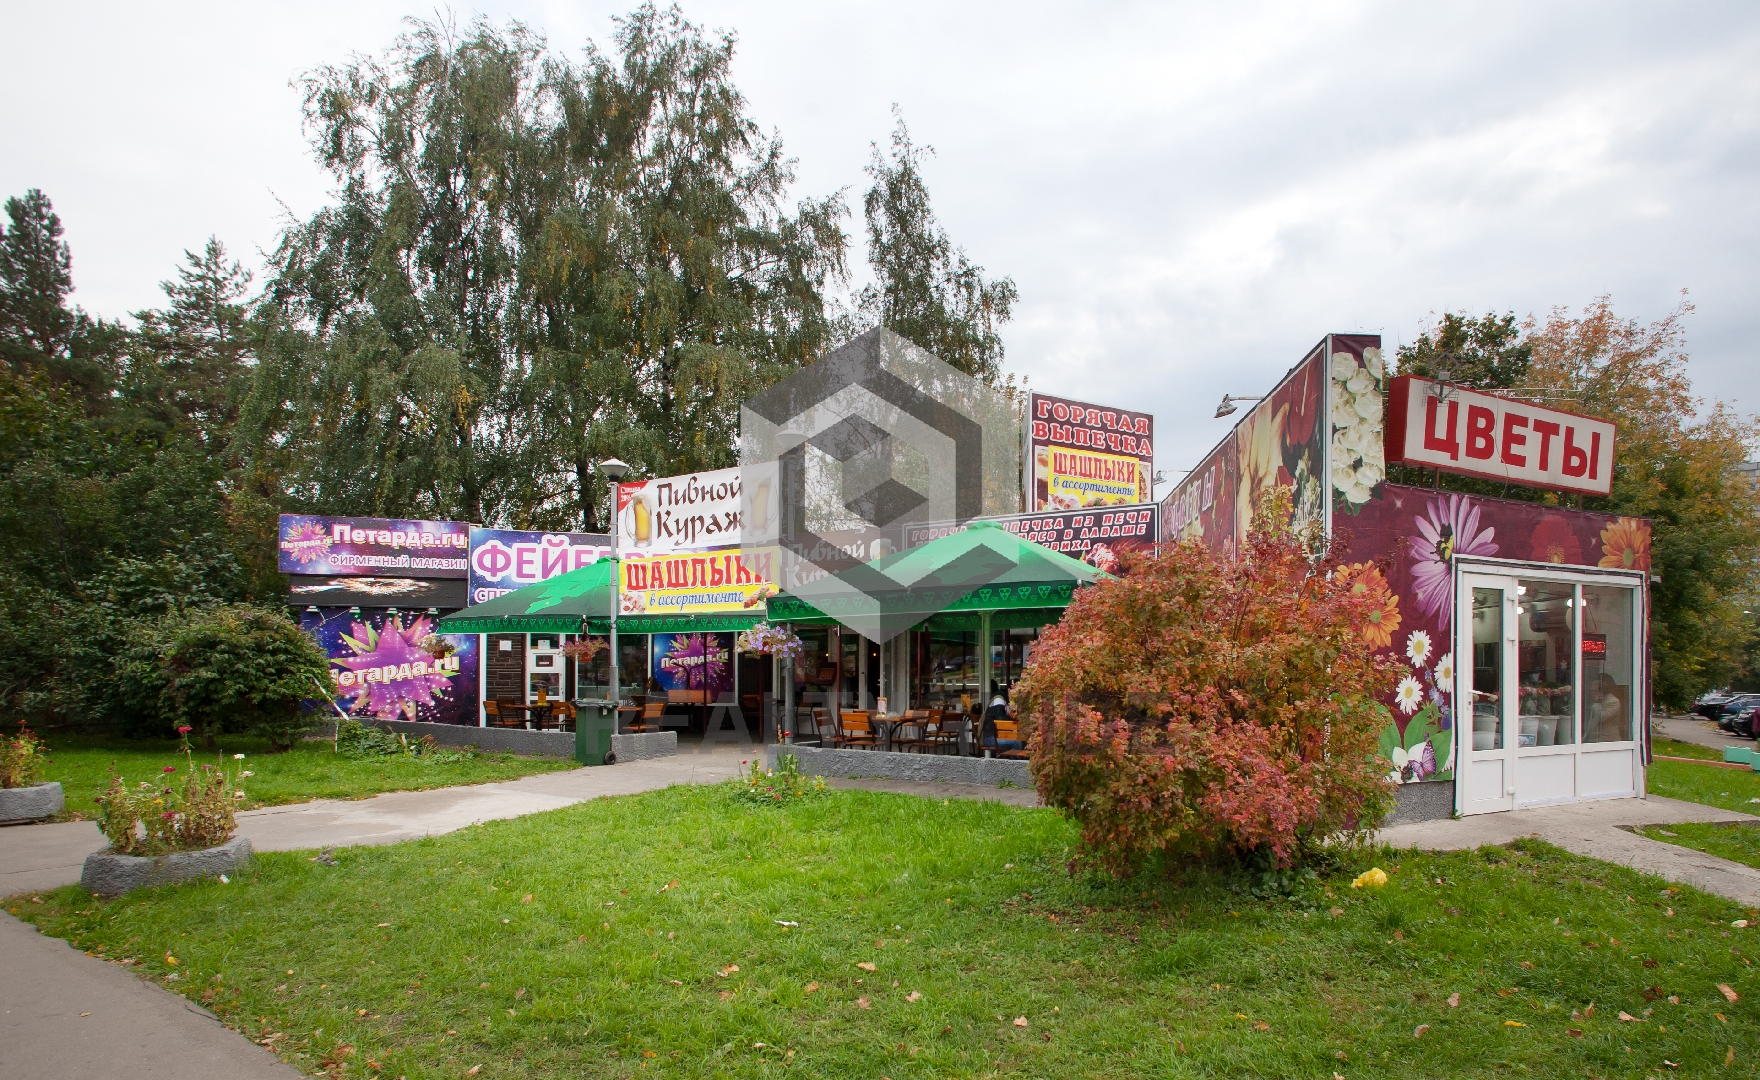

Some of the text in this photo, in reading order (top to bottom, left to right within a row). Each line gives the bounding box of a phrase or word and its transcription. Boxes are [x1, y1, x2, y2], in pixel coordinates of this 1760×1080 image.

[1037, 400, 1149, 435] ГОРЯЧАЯ
[1033, 420, 1152, 456] ВЫПЕЧКА
[1424, 396, 1600, 480] ЦВЕТЫ
[1053, 452, 1136, 484] ШАШЛЫКИ
[656, 475, 744, 508] Пивной
[1053, 476, 1135, 497] в ассортименте
[656, 509, 747, 546] Кураж
[1063, 529, 1073, 540] В
[1080, 524, 1147, 539] ЛАВАШЕ
[1072, 515, 1094, 527] ИЗ
[1102, 510, 1151, 525] ПЕЧИ
[332, 523, 468, 549] Петарда.ru
[329, 554, 468, 569] ФИРМЕННЫЙ МАГАЗИН
[626, 551, 772, 591] ШАШЛЫКИ
[650, 591, 745, 611] в ассортименте
